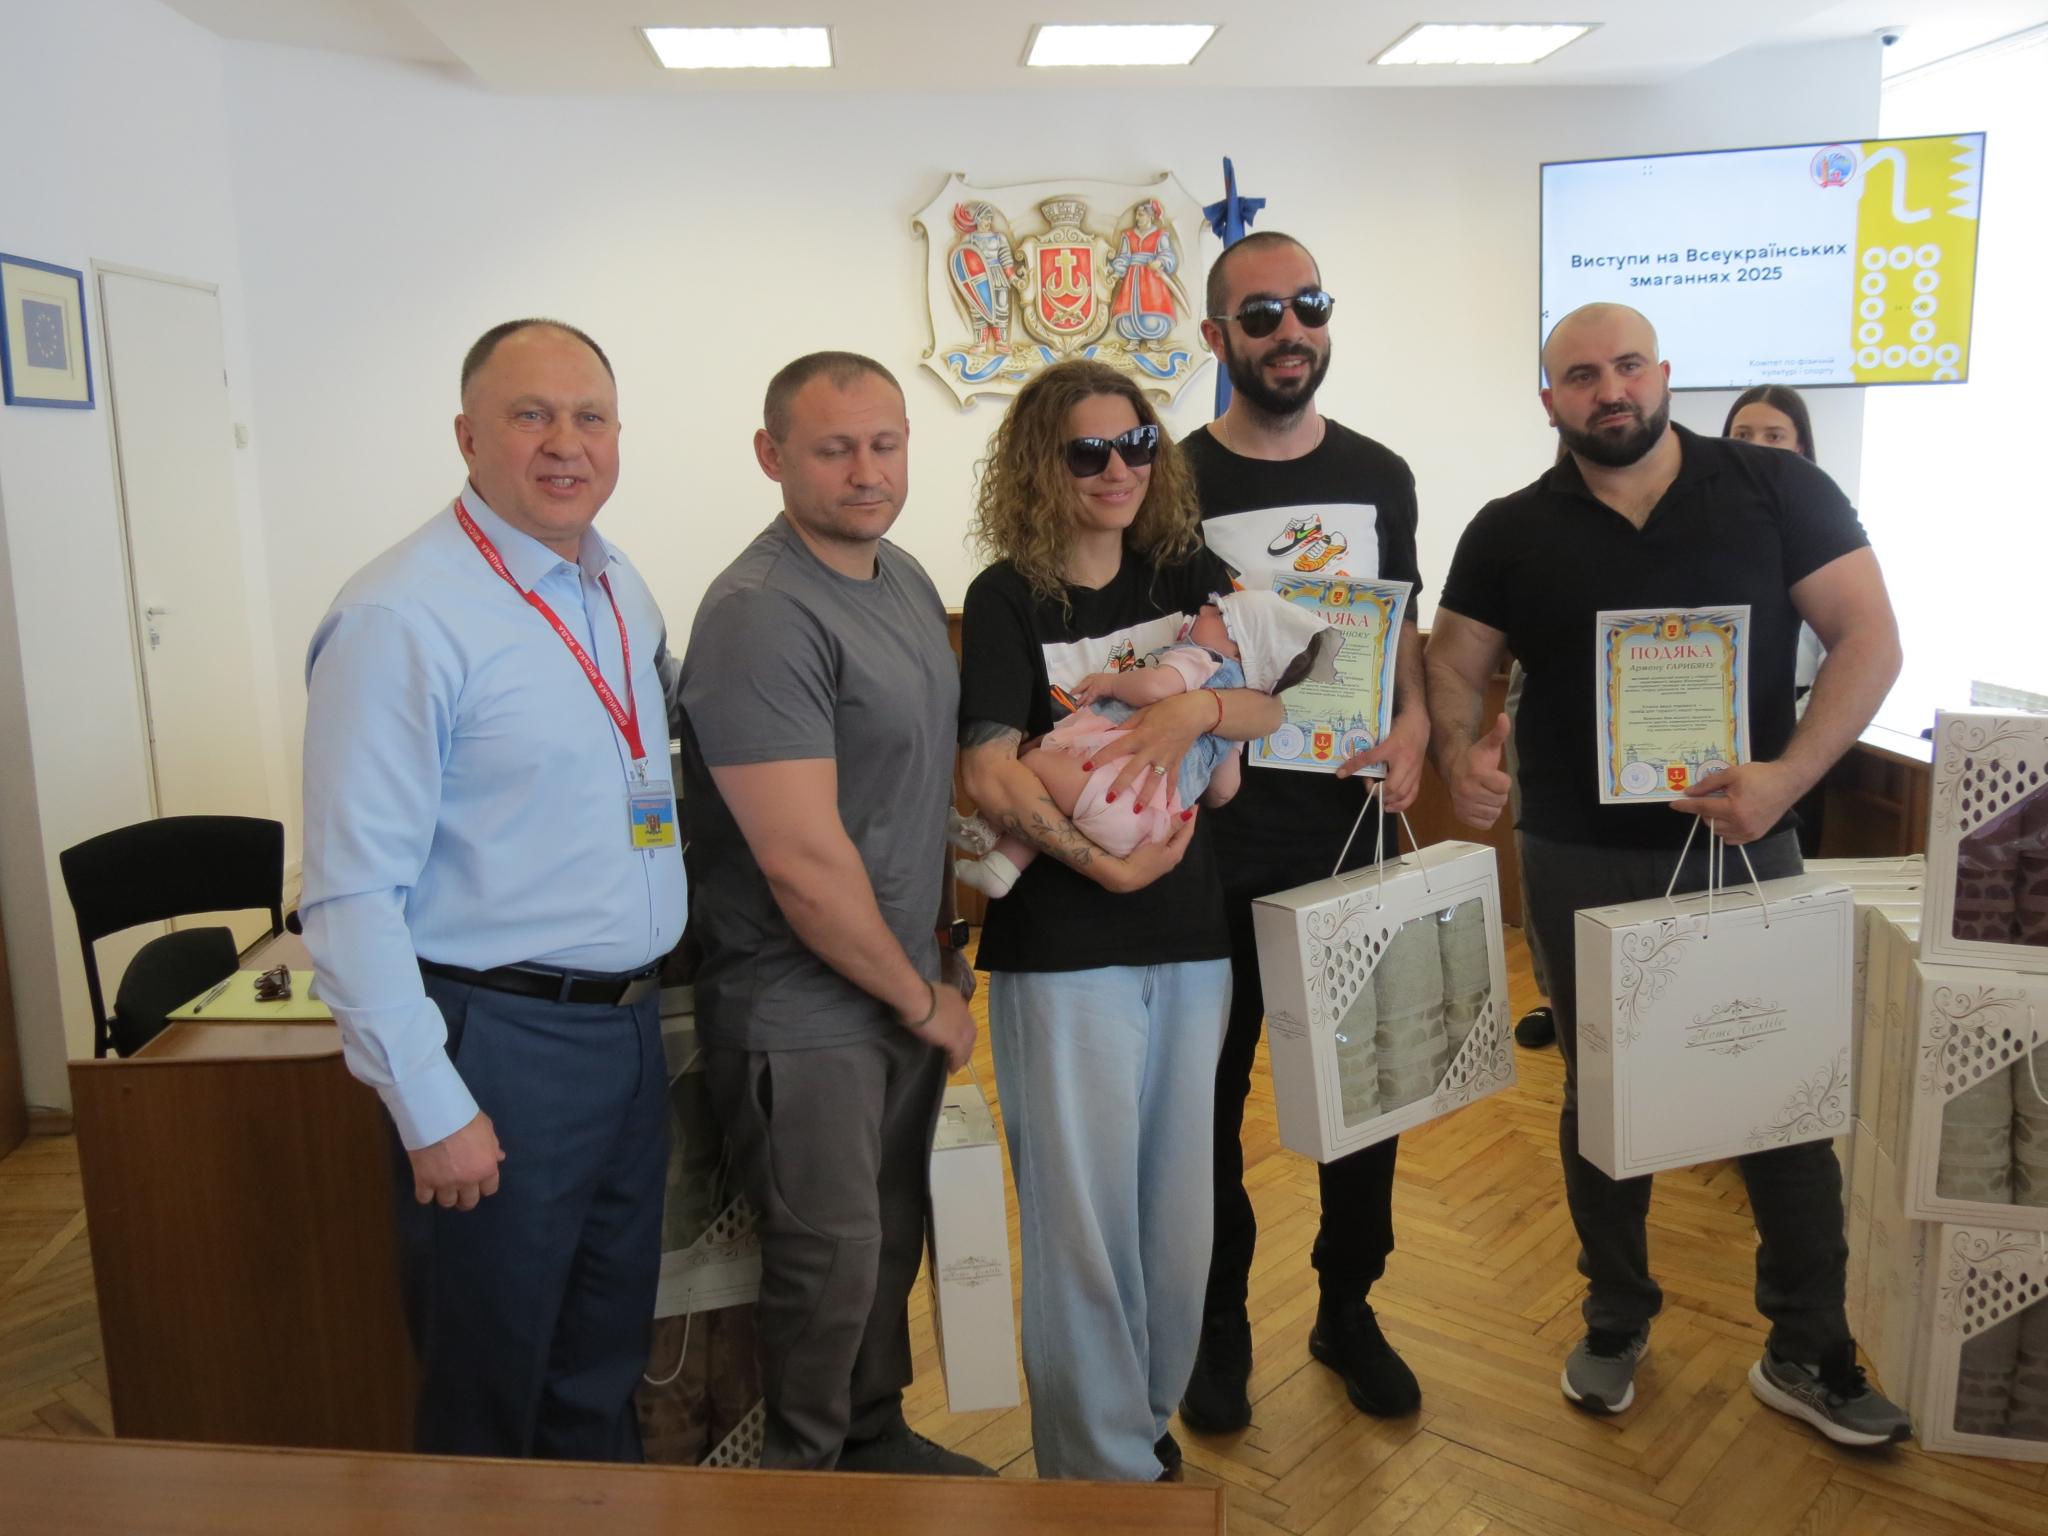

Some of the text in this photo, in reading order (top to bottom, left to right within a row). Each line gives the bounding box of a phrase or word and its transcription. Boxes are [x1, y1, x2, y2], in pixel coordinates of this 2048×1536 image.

[1571, 243, 1848, 270] Виступи на Всеукраїнських
[1630, 266, 1783, 287] змаганнях 2025
[558, 624, 576, 647] РАДА
[576, 647, 599, 680] МІСЬКА
[1630, 644, 1713, 661] ПОДЯКА
[598, 681, 628, 727] ВІННИЦЬКА
